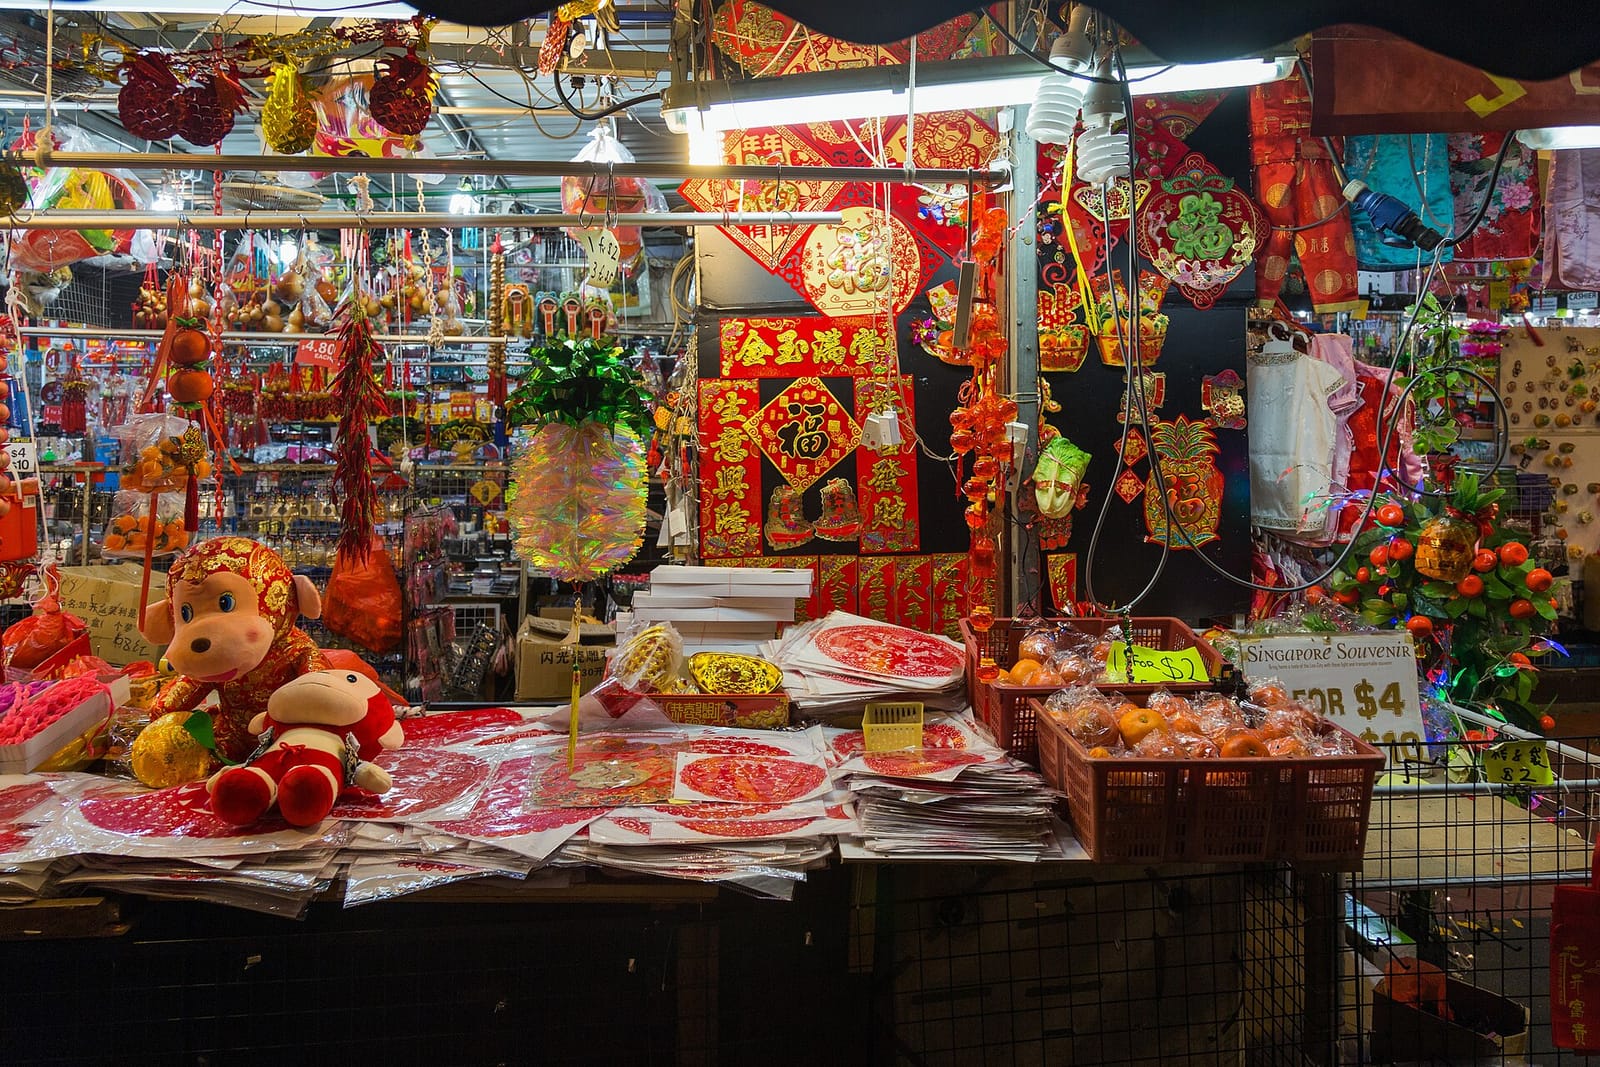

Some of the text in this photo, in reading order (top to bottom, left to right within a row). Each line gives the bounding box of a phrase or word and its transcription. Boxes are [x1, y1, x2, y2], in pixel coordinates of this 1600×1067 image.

[741, 133, 782, 153] 年年
[735, 328, 884, 367] 金玉滿堂
[777, 402, 830, 460] 福
[710, 391, 750, 534] 生意興隆
[1354, 679, 1405, 720] $4
